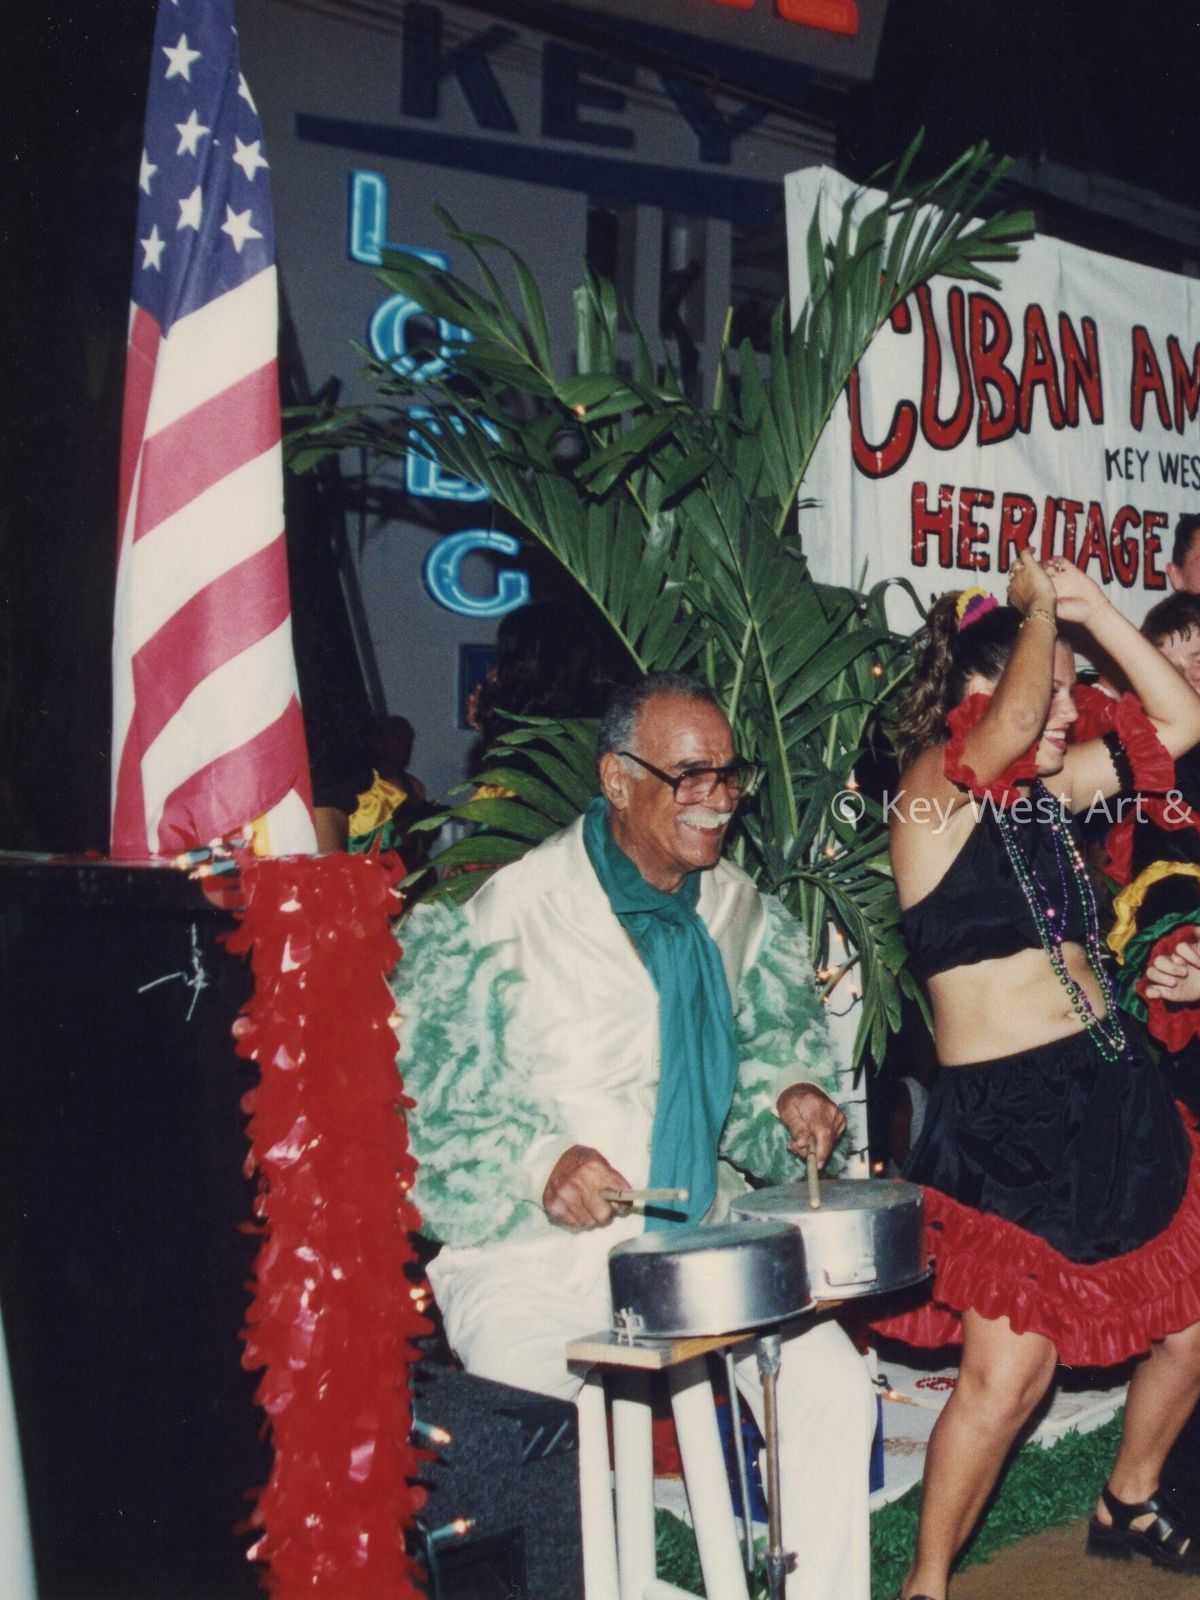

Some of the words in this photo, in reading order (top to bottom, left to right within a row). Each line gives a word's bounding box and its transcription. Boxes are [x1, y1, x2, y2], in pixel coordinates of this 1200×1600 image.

[401, 3, 778, 165] KEY
[844, 270, 1104, 479] CUBAN
[1104, 447, 1150, 482] KEY
[911, 481, 1169, 591] HERITAGE
